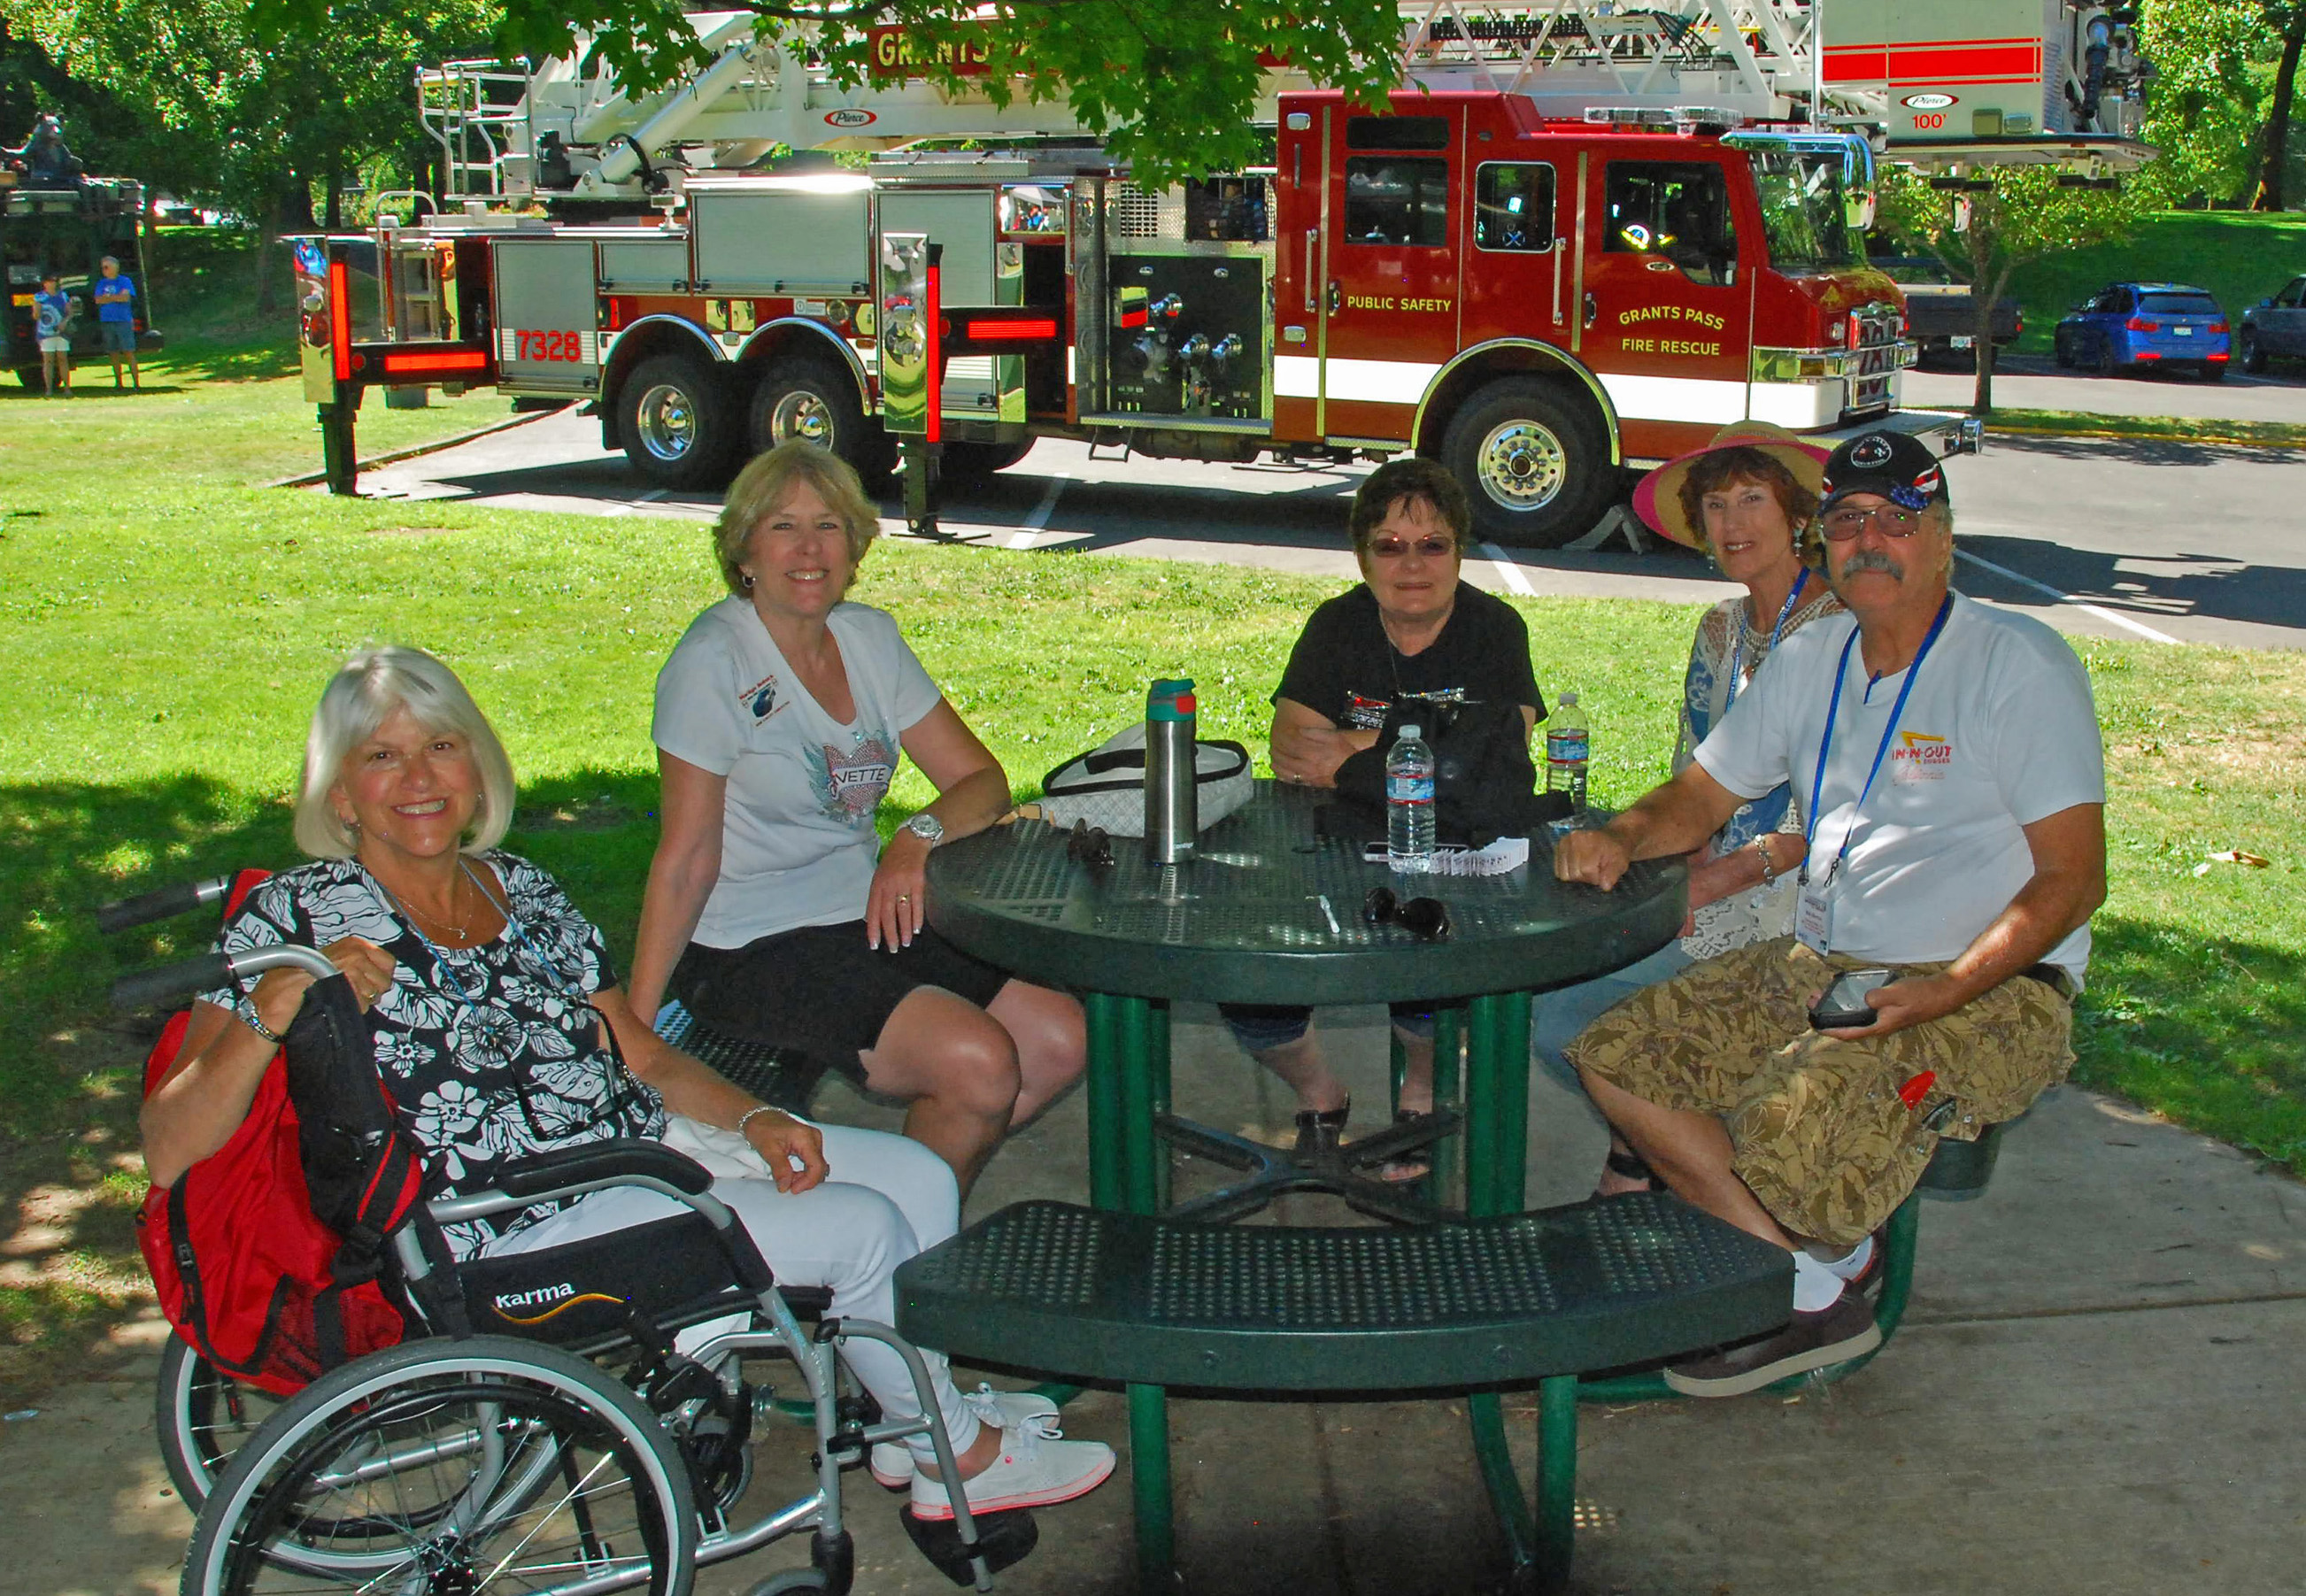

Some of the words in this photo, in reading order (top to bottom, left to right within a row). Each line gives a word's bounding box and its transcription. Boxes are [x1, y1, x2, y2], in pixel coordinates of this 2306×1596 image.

[1912, 96, 1946, 105] Pierce
[836, 112, 864, 124] Pierce
[1347, 296, 1394, 310] PUBLIC
[1400, 297, 1451, 312] SAFETY
[1619, 305, 1681, 325] GRANTS
[1685, 307, 1724, 330] PASS
[516, 328, 581, 363] 7328
[1622, 338, 1654, 352] FIRE
[1661, 340, 1721, 356] RESCUE
